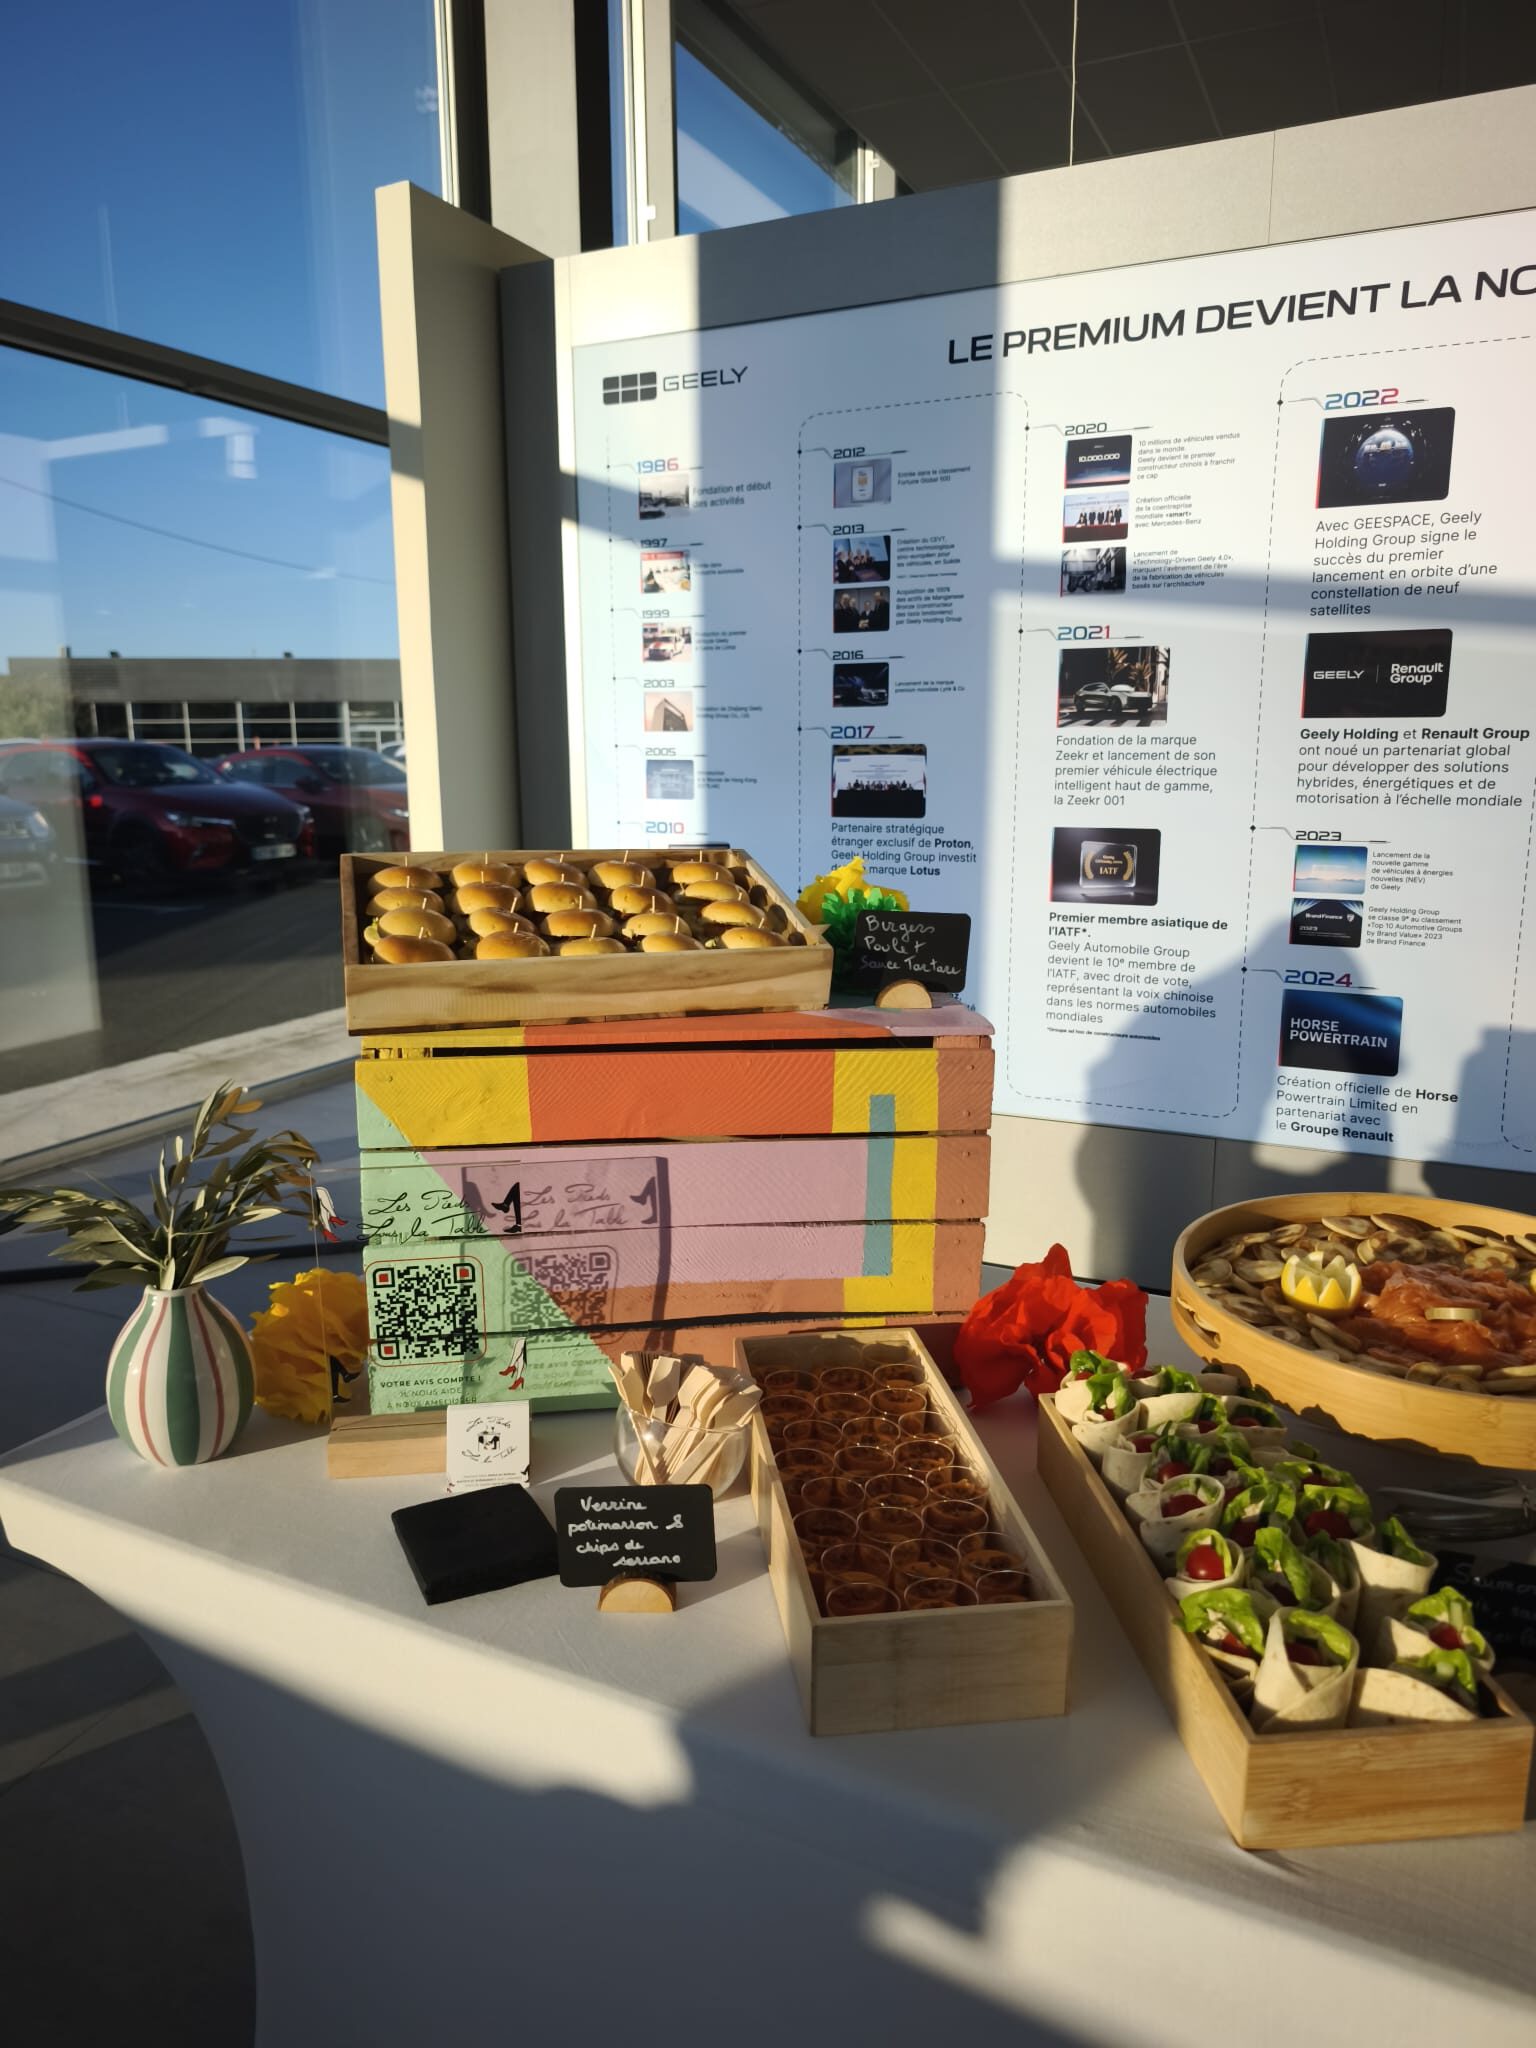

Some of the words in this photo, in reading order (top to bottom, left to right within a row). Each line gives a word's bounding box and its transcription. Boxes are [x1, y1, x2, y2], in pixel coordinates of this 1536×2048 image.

[949, 334, 993, 364] LE
[1003, 309, 1185, 357] PREMIUM
[1196, 283, 1391, 333] DEVIENT
[1401, 275, 1462, 309] LA
[663, 366, 748, 392] GEELY
[1325, 388, 1399, 410] 2022
[1065, 422, 1107, 436] 2020
[1183, 433, 1214, 443] véhicules
[1216, 432, 1240, 440] vendus
[833, 447, 865, 459] 2012
[1138, 455, 1155, 463] Geely
[1158, 454, 1181, 462] devient
[1190, 451, 1216, 460] premier
[637, 458, 679, 473] 1986
[693, 485, 733, 495] ondation
[736, 484, 744, 492] et
[746, 481, 771, 491] début
[1316, 520, 1349, 532] Avec
[1354, 514, 1434, 530] GEESPACE,
[1440, 511, 1482, 528] Geely
[833, 524, 864, 535] 2013
[640, 538, 668, 548] 1997
[1315, 535, 1368, 549] Holding
[1373, 533, 1415, 547] Group
[1421, 531, 1459, 545] signe
[1464, 529, 1476, 540] le
[1311, 585, 1399, 600] constellation
[1404, 584, 1422, 596] de
[1427, 581, 1460, 594] neuf
[642, 610, 670, 618] 1999
[1310, 603, 1371, 616] satellites
[1057, 625, 1110, 640] 2021
[832, 650, 864, 660] 2016
[1391, 662, 1443, 674] Renault
[1313, 670, 1365, 680] GEELY
[1390, 673, 1432, 685] Group
[643, 679, 675, 688] 2003
[830, 725, 875, 739] 2017
[1300, 729, 1340, 741] Geely
[1343, 728, 1398, 741] Holding
[1403, 729, 1416, 740] et
[1421, 728, 1478, 739] Renault
[1482, 728, 1530, 741] Group
[1056, 735, 1114, 746] Fondation
[1118, 735, 1133, 745] de
[1137, 735, 1147, 745] la
[1150, 735, 1197, 748] marque
[645, 748, 676, 756] 2005
[1056, 750, 1089, 761] Zeekr
[1092, 751, 1104, 761] et
[1108, 750, 1170, 761] lancement
[1174, 750, 1190, 761] de
[1194, 752, 1216, 761] son
[1297, 776, 1357, 789] hybrides,
[1363, 777, 1454, 791] énergétiques
[1459, 779, 1473, 789] et
[1477, 778, 1496, 789] de
[1054, 795, 1063, 805] la
[1067, 795, 1100, 806] Zeekr
[1104, 795, 1125, 806] 001
[646, 821, 685, 834] 2010
[831, 822, 882, 833] Partenaire
[886, 823, 944, 836] stratégique
[1296, 831, 1342, 841] 2023
[831, 837, 873, 848] étranger
[876, 838, 915, 848] exclusif
[918, 839, 931, 848] de
[934, 838, 974, 850] Proton,
[862, 851, 901, 862] Holding
[904, 852, 935, 862] Group
[938, 853, 977, 863] investit
[869, 865, 907, 876] marque
[910, 866, 940, 876] Lotus
[1099, 867, 1118, 875] IATF
[1371, 875, 1404, 883] nouvelles
[1405, 876, 1426, 884] (NEV)
[1369, 906, 1388, 914] Geely
[1390, 907, 1417, 916] Holding
[1418, 908, 1440, 916] Group
[1049, 912, 1095, 924] Premier
[1098, 915, 1148, 926] membre
[1151, 917, 1208, 930] asiatique
[1212, 920, 1228, 930] de
[865, 915, 935, 942] Burgers
[1048, 940, 1080, 952] Geely
[1084, 943, 1149, 955] Automobile
[1153, 946, 1190, 958] Group
[904, 955, 961, 975] Tartare
[1284, 970, 1352, 987] 2024
[1047, 983, 1119, 997] représentant
[1123, 985, 1132, 998] la
[1136, 986, 1160, 999] voix
[1164, 990, 1214, 1003] chinoise
[1290, 1018, 1340, 1032] HORSE
[1290, 1030, 1388, 1048] POWERTRAIN
[1277, 1075, 1331, 1090] Création
[1335, 1081, 1390, 1096] officielle
[1395, 1087, 1412, 1098] de
[1416, 1088, 1458, 1102] Horse
[1276, 1120, 1287, 1130] le
[1290, 1121, 1339, 1137] Groupe
[1342, 1126, 1394, 1142] Renault
[368, 1192, 411, 1215] Les
[380, 1380, 411, 1388] VOTRE
[414, 1378, 435, 1386] AVIS
[437, 1376, 476, 1385] COMPTE
[580, 1496, 647, 1512] Verrine
[568, 1519, 659, 1537] potimarron
[576, 1539, 619, 1555] chips
[625, 1539, 645, 1550] de
[612, 1555, 681, 1567] serrano
